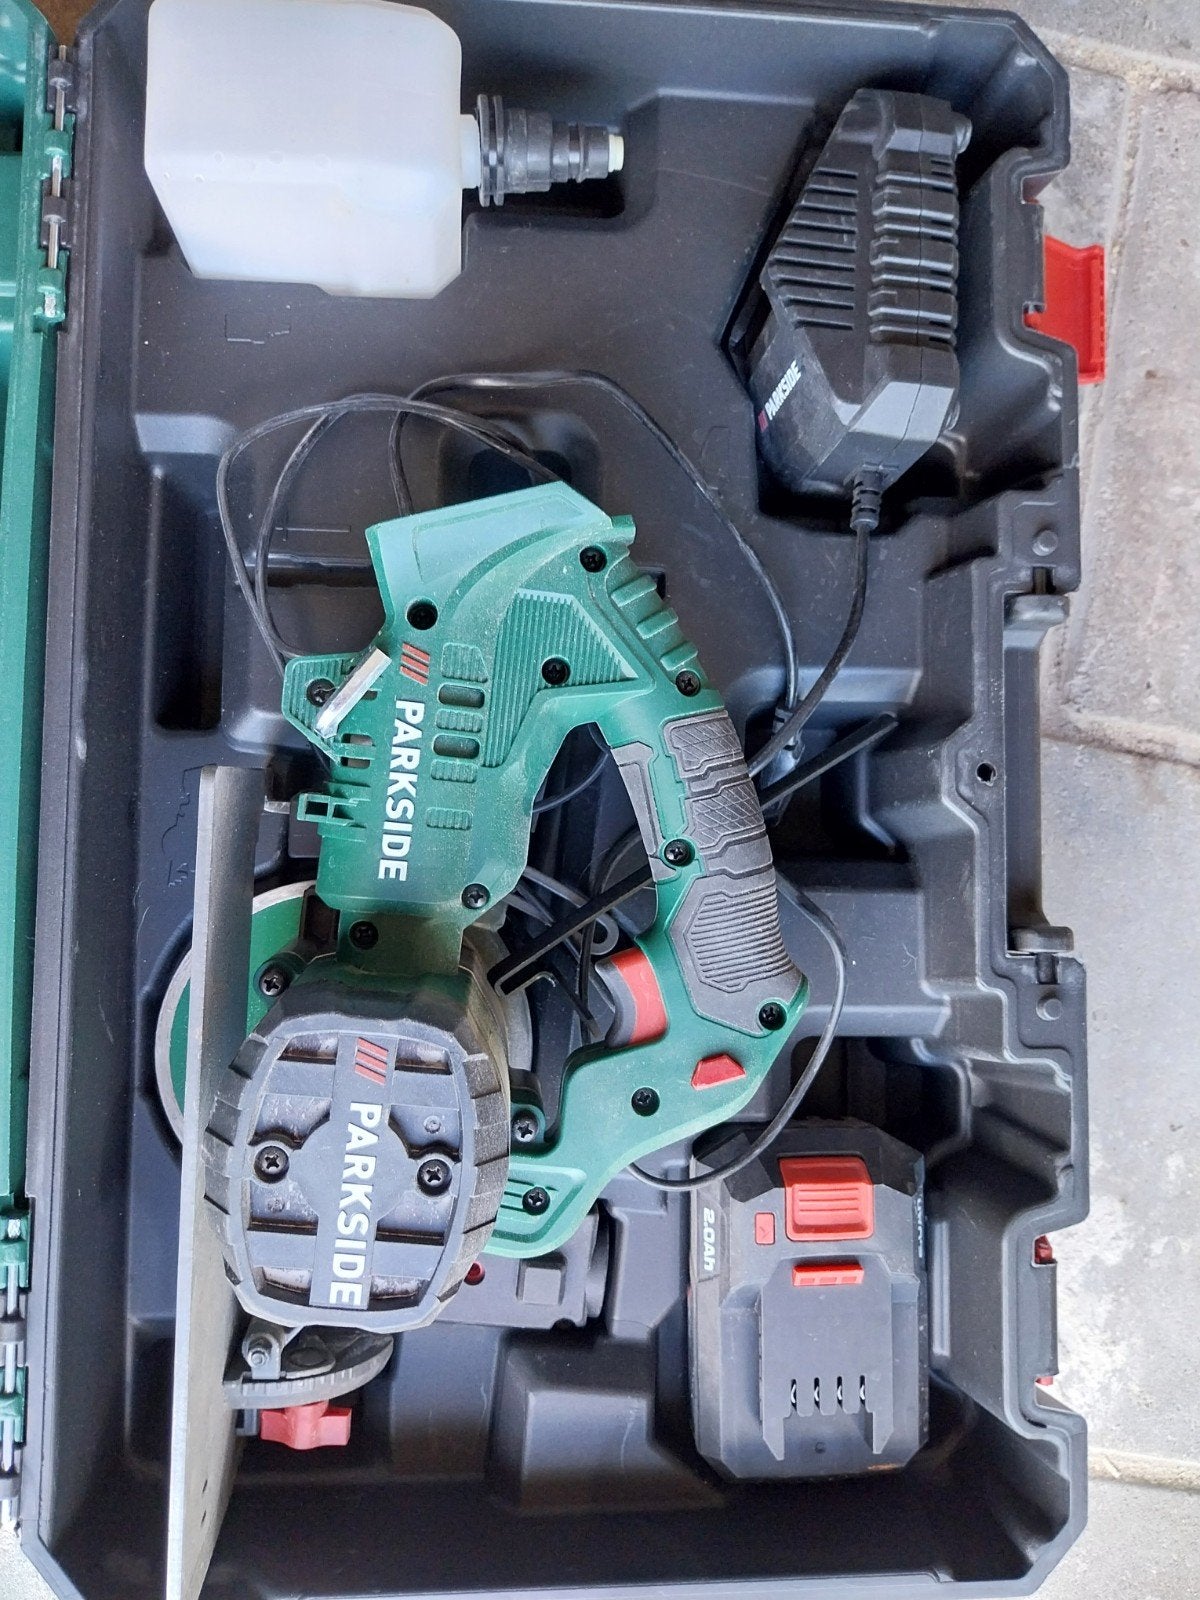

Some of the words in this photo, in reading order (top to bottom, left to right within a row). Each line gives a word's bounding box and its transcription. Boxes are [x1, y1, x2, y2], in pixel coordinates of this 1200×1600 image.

[764, 359, 801, 420] PARKSIDE
[378, 700, 425, 881] PARKSIDE
[329, 1102, 382, 1305] PARKSIDE
[703, 1207, 716, 1271] 2.0Ah
